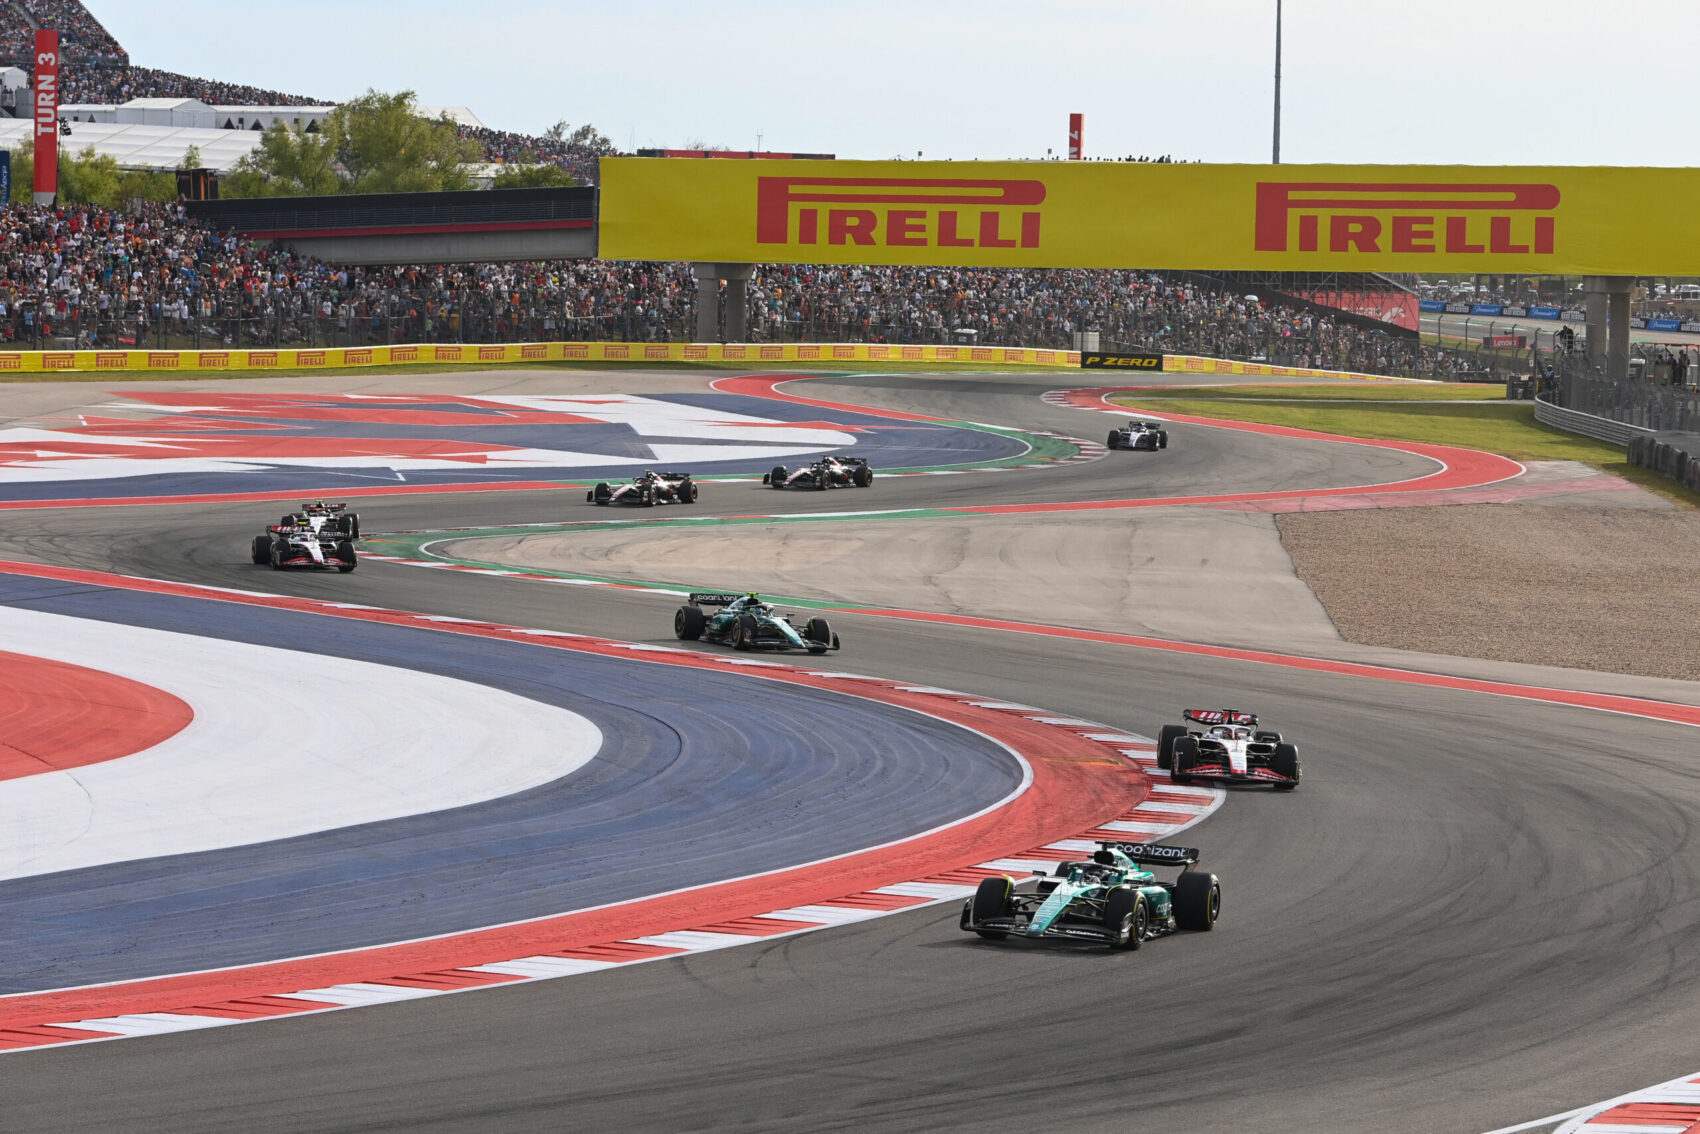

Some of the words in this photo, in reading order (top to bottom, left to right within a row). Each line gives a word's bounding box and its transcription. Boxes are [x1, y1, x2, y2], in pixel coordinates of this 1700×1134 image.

[37, 52, 56, 66] 3
[37, 74, 56, 136] TURN
[757, 176, 1047, 248] PIRELLI
[1255, 182, 1561, 254] PIRELLI
[43, 353, 75, 368] PIRELLI
[96, 352, 128, 367] PIRELLI
[149, 352, 179, 366] PIRELLI
[199, 352, 229, 366] PIRELLI
[249, 352, 278, 365] PIRELLI
[297, 351, 325, 365] PIRELLI
[345, 349, 372, 363] PIRELLI
[391, 346, 418, 360] PIRELLI
[436, 346, 461, 360] PIRELLI
[479, 346, 504, 360] PIRELLI
[522, 344, 547, 358] PIRELLI
[564, 344, 588, 358] PIRELLI
[605, 345, 629, 358] PIRELLI
[645, 345, 669, 358] PIRELLI
[723, 345, 746, 358] PIRELLI
[1086, 357, 1100, 365] P
[1103, 357, 1157, 366] ZERO
